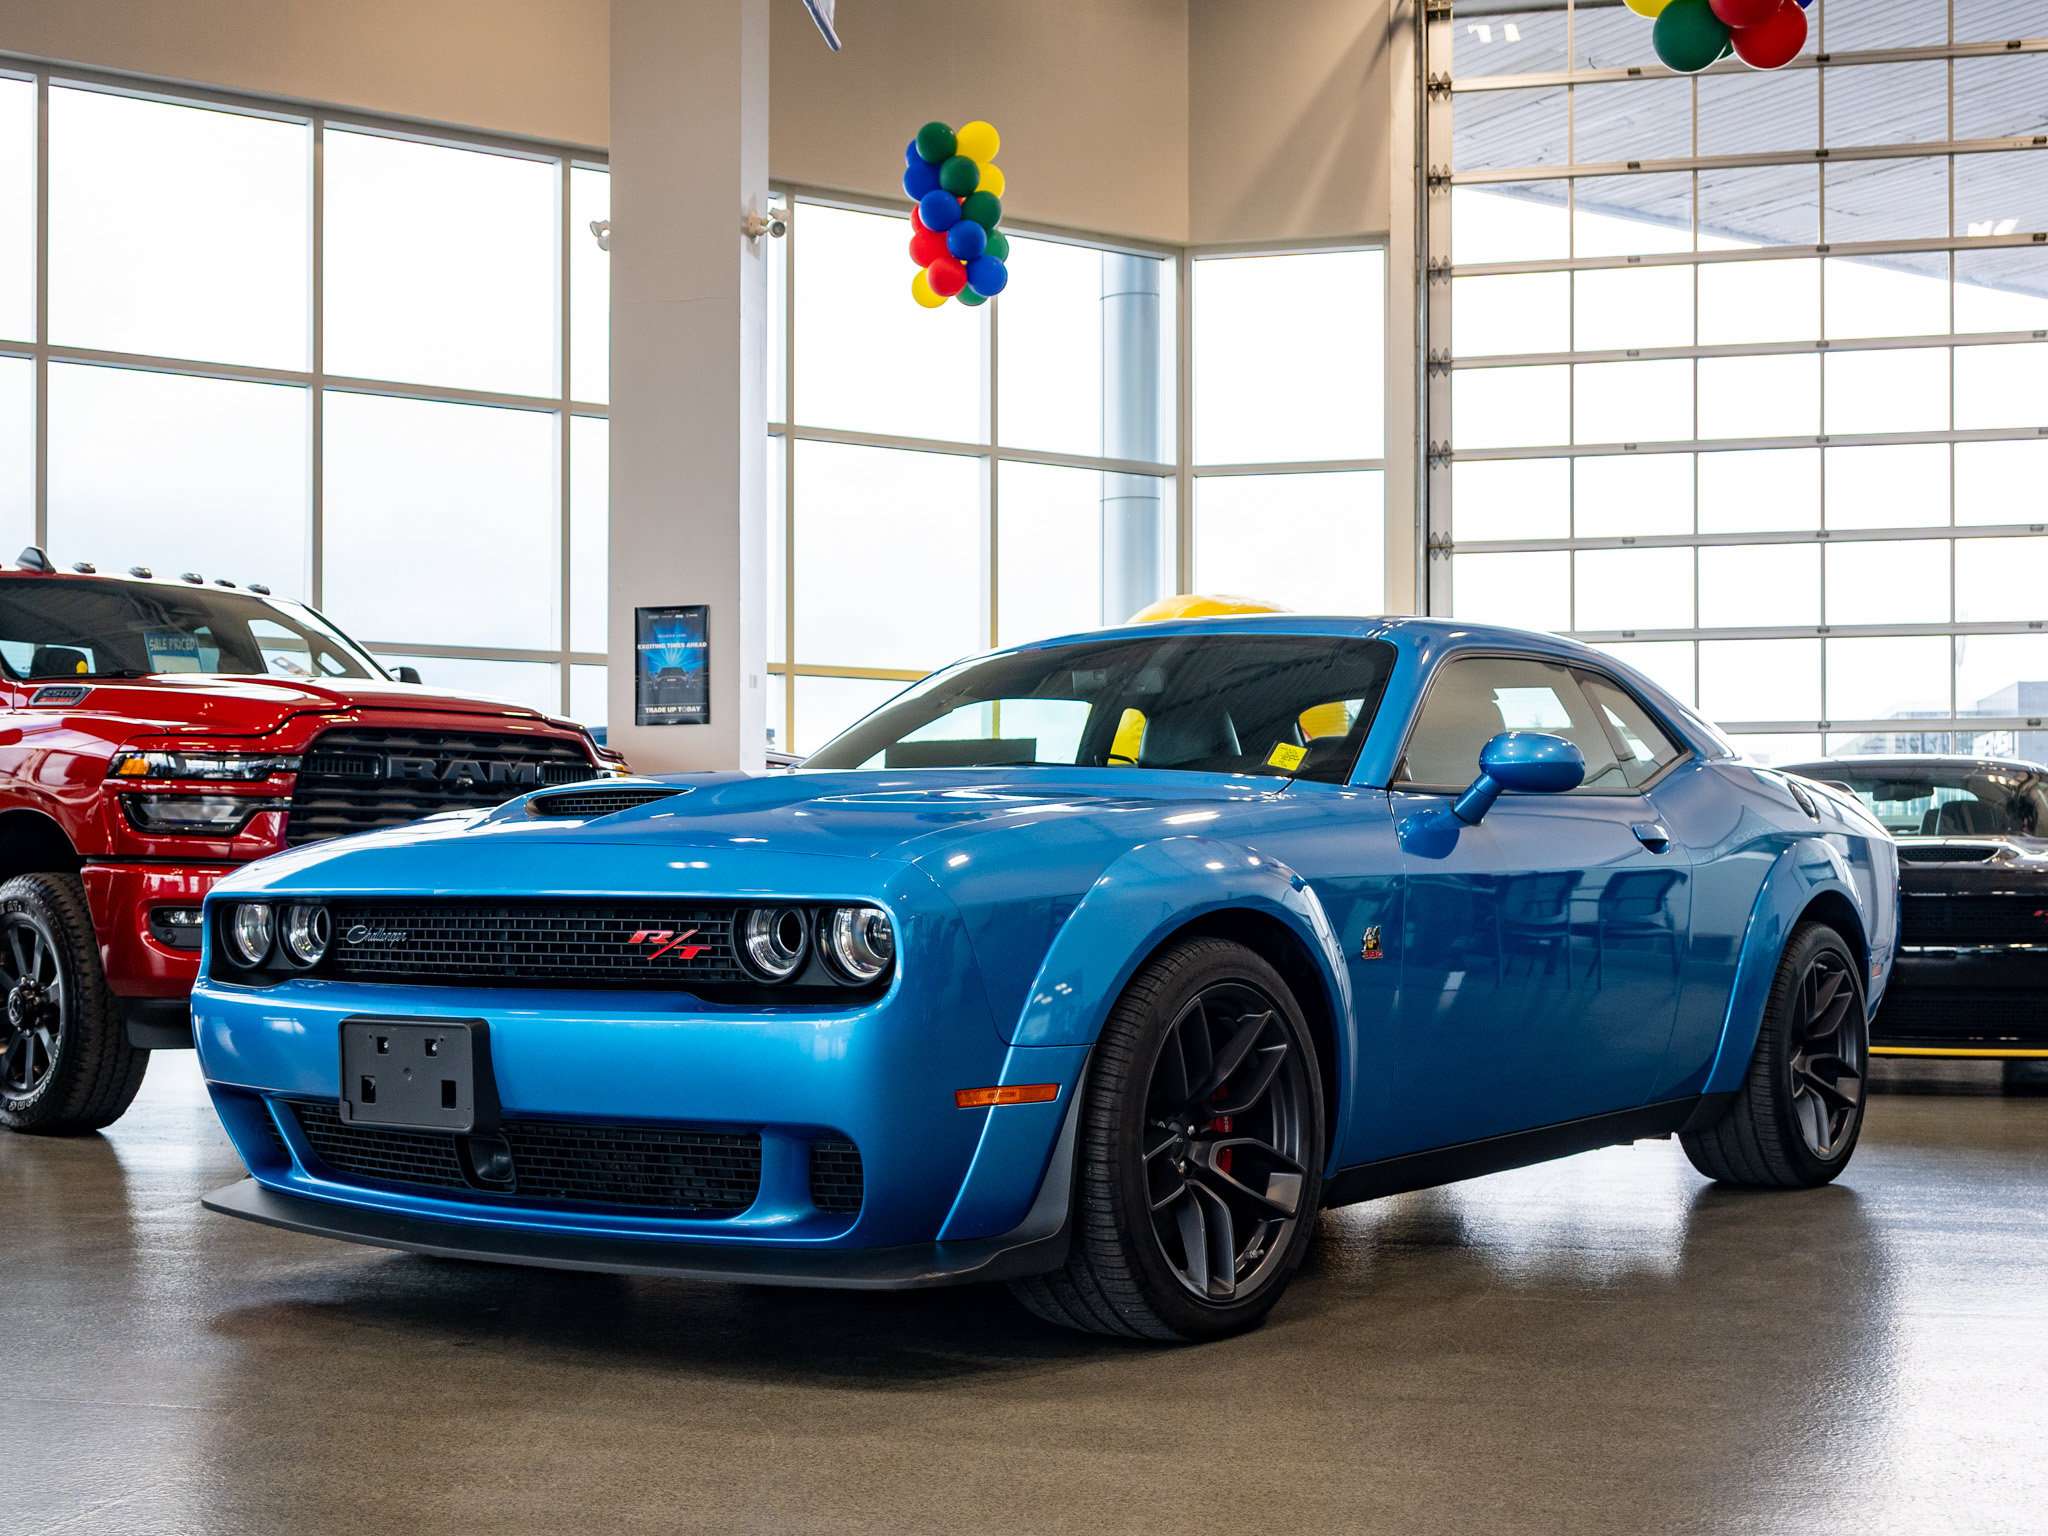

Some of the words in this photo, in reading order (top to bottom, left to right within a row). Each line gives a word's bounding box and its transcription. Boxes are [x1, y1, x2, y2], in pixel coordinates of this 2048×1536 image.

[149, 638, 168, 651] SALE
[386, 756, 536, 785] RAM
[346, 924, 407, 948] Challenger
[628, 928, 712, 960] R/T
